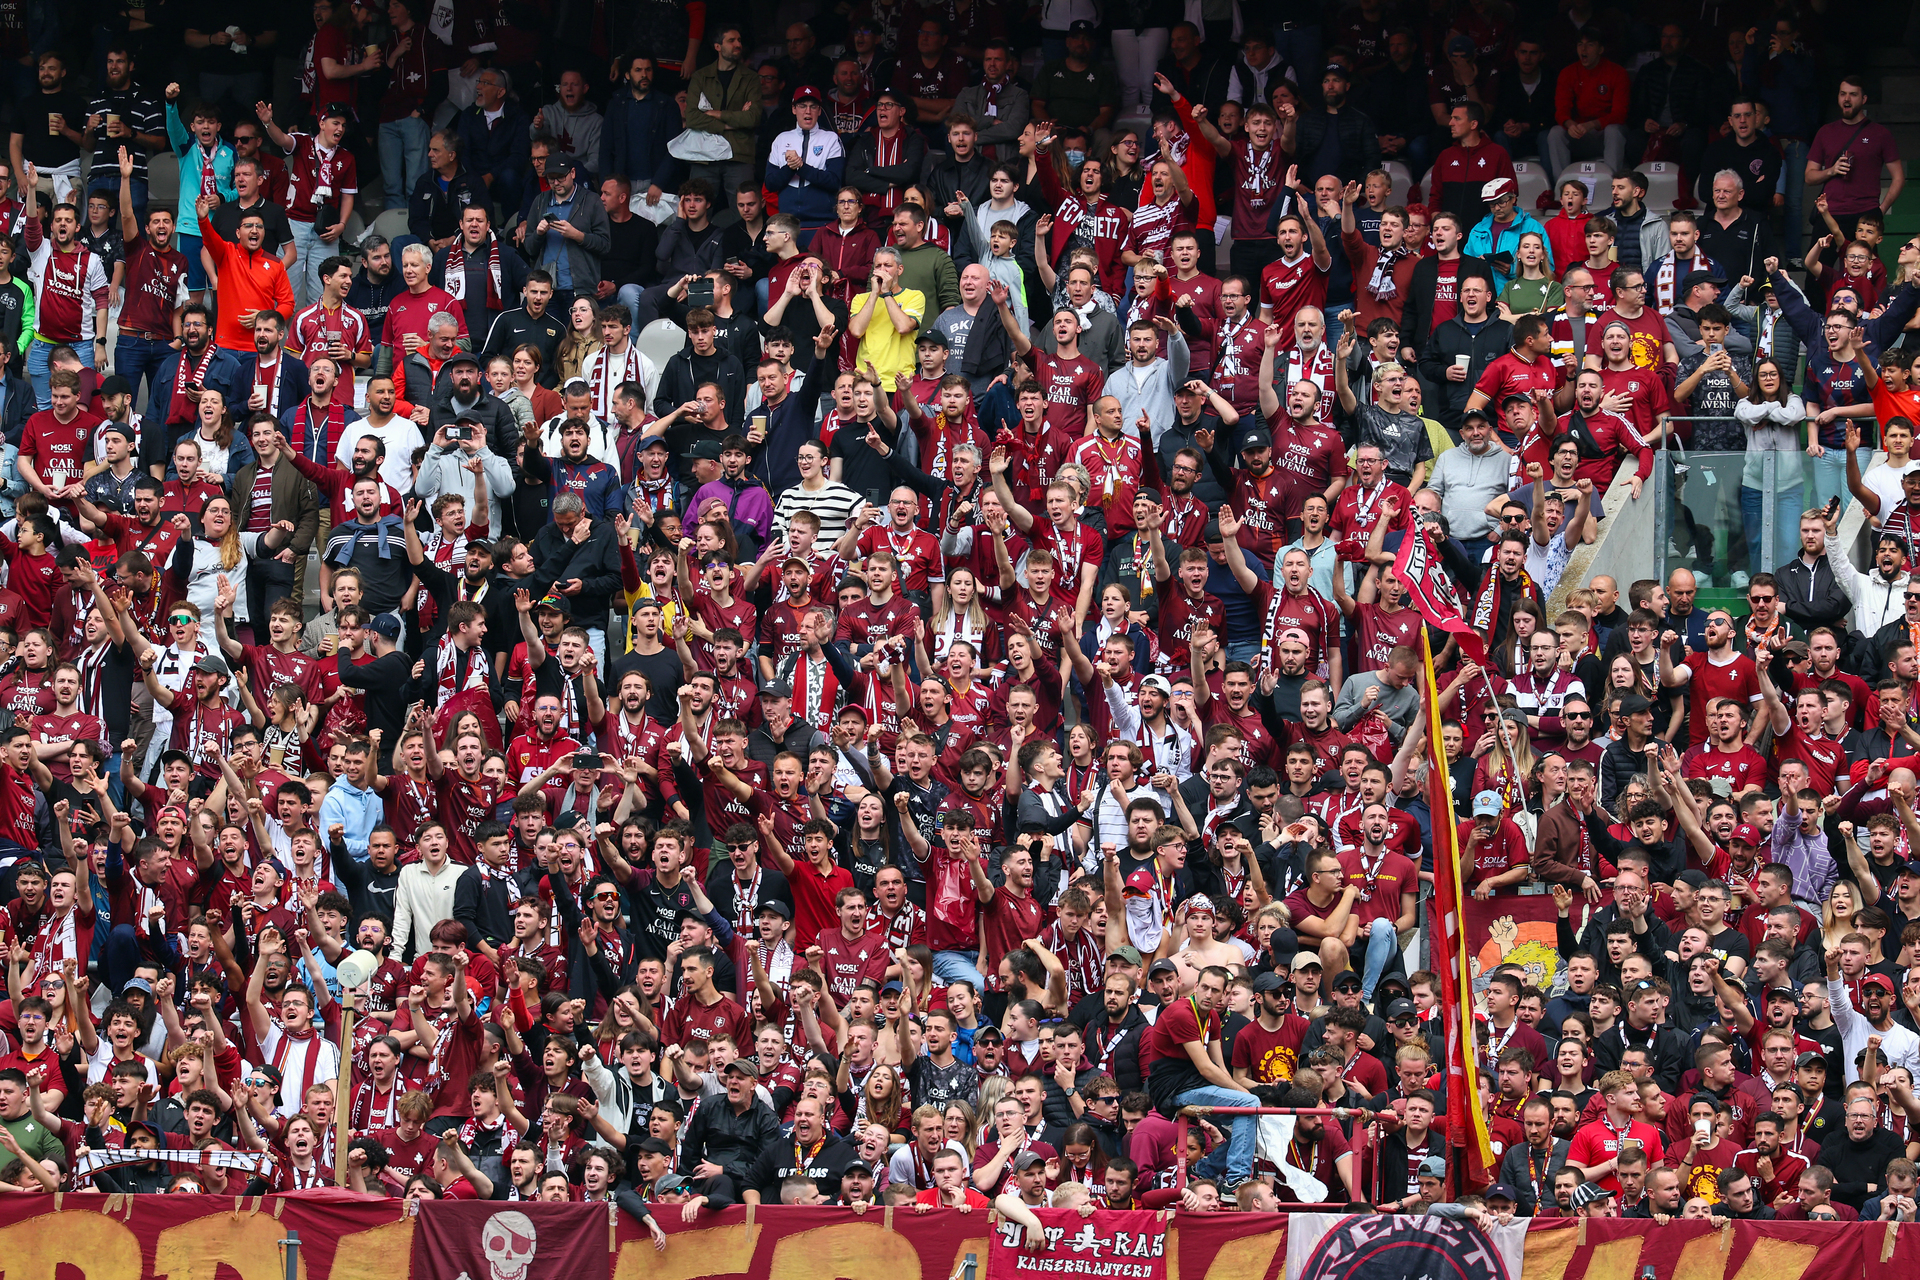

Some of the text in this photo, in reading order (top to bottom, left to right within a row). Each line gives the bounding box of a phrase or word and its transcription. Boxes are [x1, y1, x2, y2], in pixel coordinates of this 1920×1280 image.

[1655, 163, 1661, 171] 15
[1275, 279, 1298, 289] Moselle
[1052, 375, 1074, 384] MOSL
[1830, 380, 1855, 388] MOSL
[1047, 393, 1079, 406] VENUE
[1707, 392, 1730, 401] CAR
[1701, 400, 1736, 409] AVENUE
[51, 443, 73, 452] MOSL
[1288, 442, 1313, 456] MOSL
[49, 458, 74, 468] CAR
[1284, 451, 1308, 465] CAR
[1276, 457, 1315, 477] AVENUE
[1095, 470, 1134, 480] SOAC
[565, 479, 587, 488] MOSL
[252, 489, 271, 498] SOLL
[1247, 496, 1268, 509] MOSL
[1245, 508, 1267, 520] CAR
[1350, 531, 1370, 541] CAR
[92, 555, 117, 566] NIKE
[1278, 615, 1302, 625] MOSL
[867, 624, 888, 632] MOSL
[783, 633, 800, 641] MOS
[1376, 631, 1399, 643] MOSL
[1035, 643, 1054, 654] NUE
[1366, 649, 1389, 663] AVEN
[272, 670, 295, 683] MOSL
[13, 695, 36, 704] CAR
[6, 703, 43, 715] AVENUE
[50, 734, 71, 743] MOSL
[1495, 786, 1519, 797] CR
[466, 804, 487, 817] MOSL
[724, 802, 751, 815] AVEN
[974, 828, 992, 837] MOSL
[1483, 856, 1507, 864] SOLLAC
[854, 861, 878, 874] MOSL
[654, 918, 675, 932] CAR
[835, 962, 858, 972] MOSL
[834, 976, 857, 987] CAR
[370, 1002, 390, 1011] NUE
